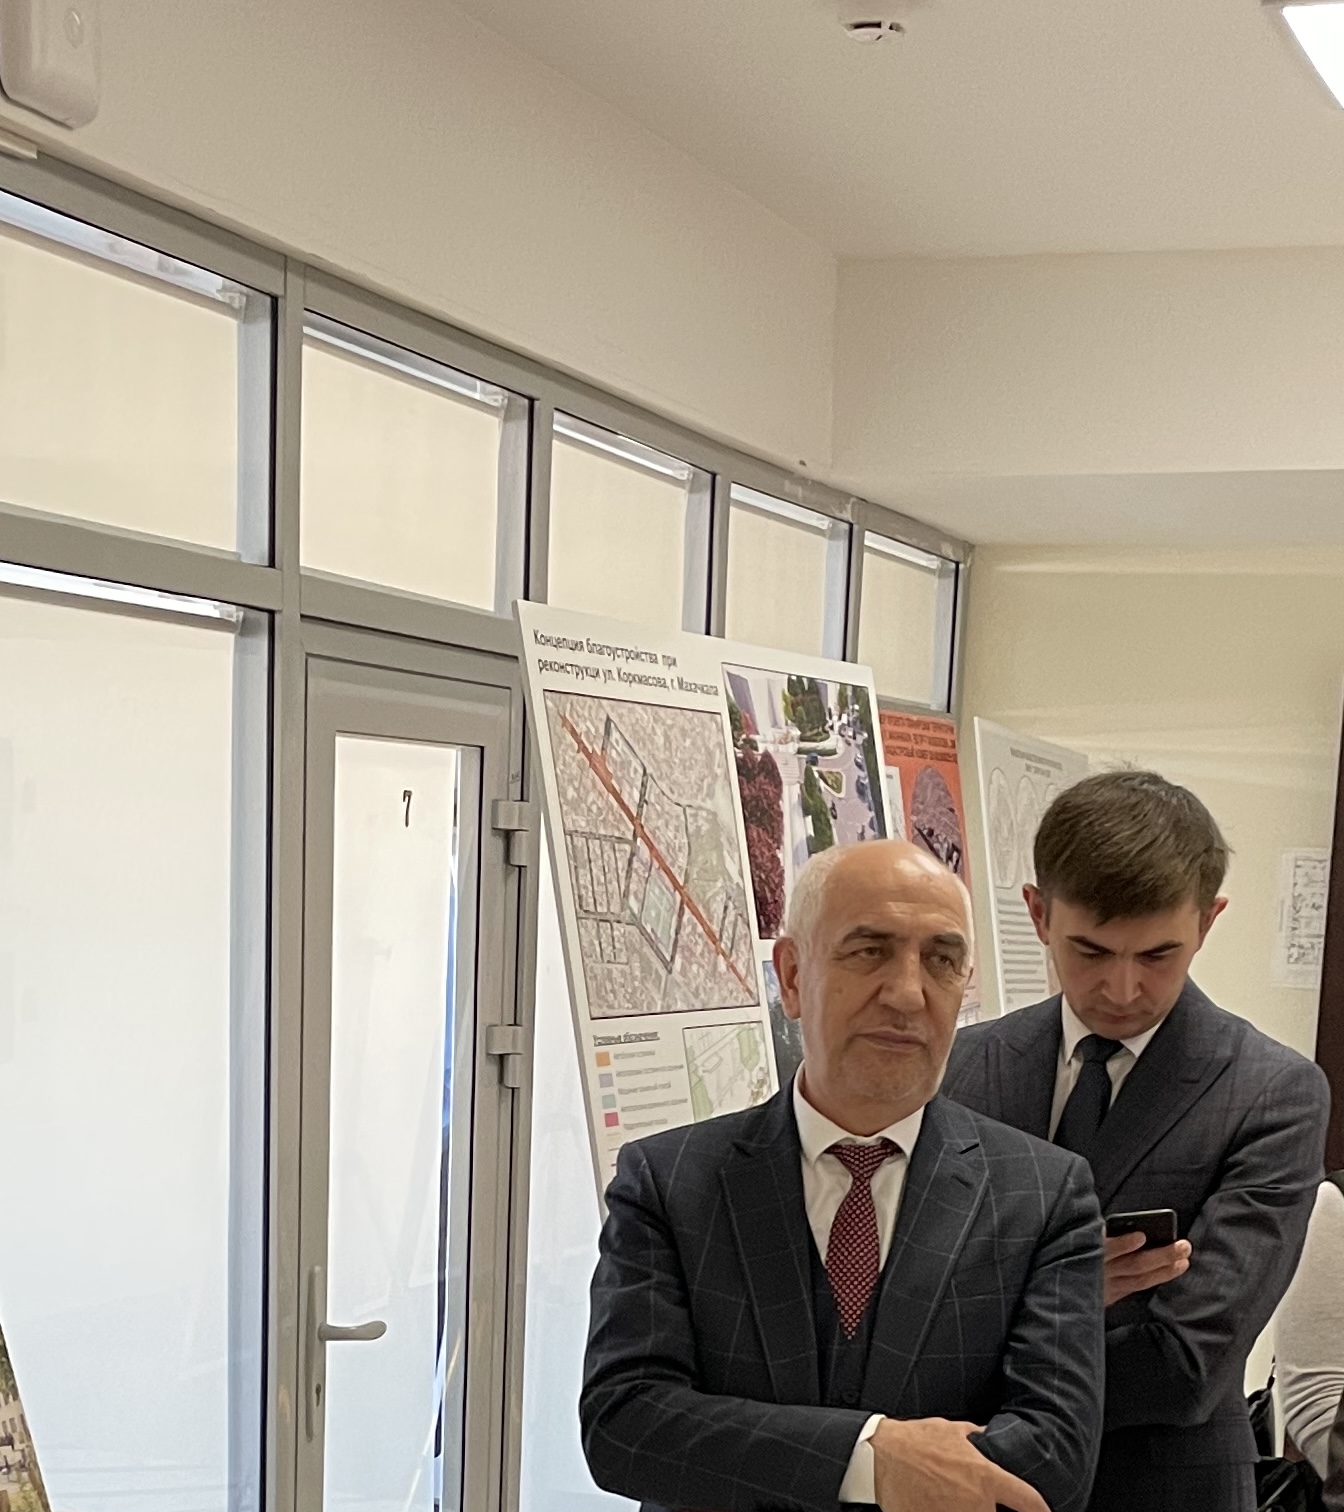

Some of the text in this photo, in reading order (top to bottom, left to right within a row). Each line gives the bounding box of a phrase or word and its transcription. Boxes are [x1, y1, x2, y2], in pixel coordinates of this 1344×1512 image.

[533, 628, 678, 670] Концепция благоустройства при
